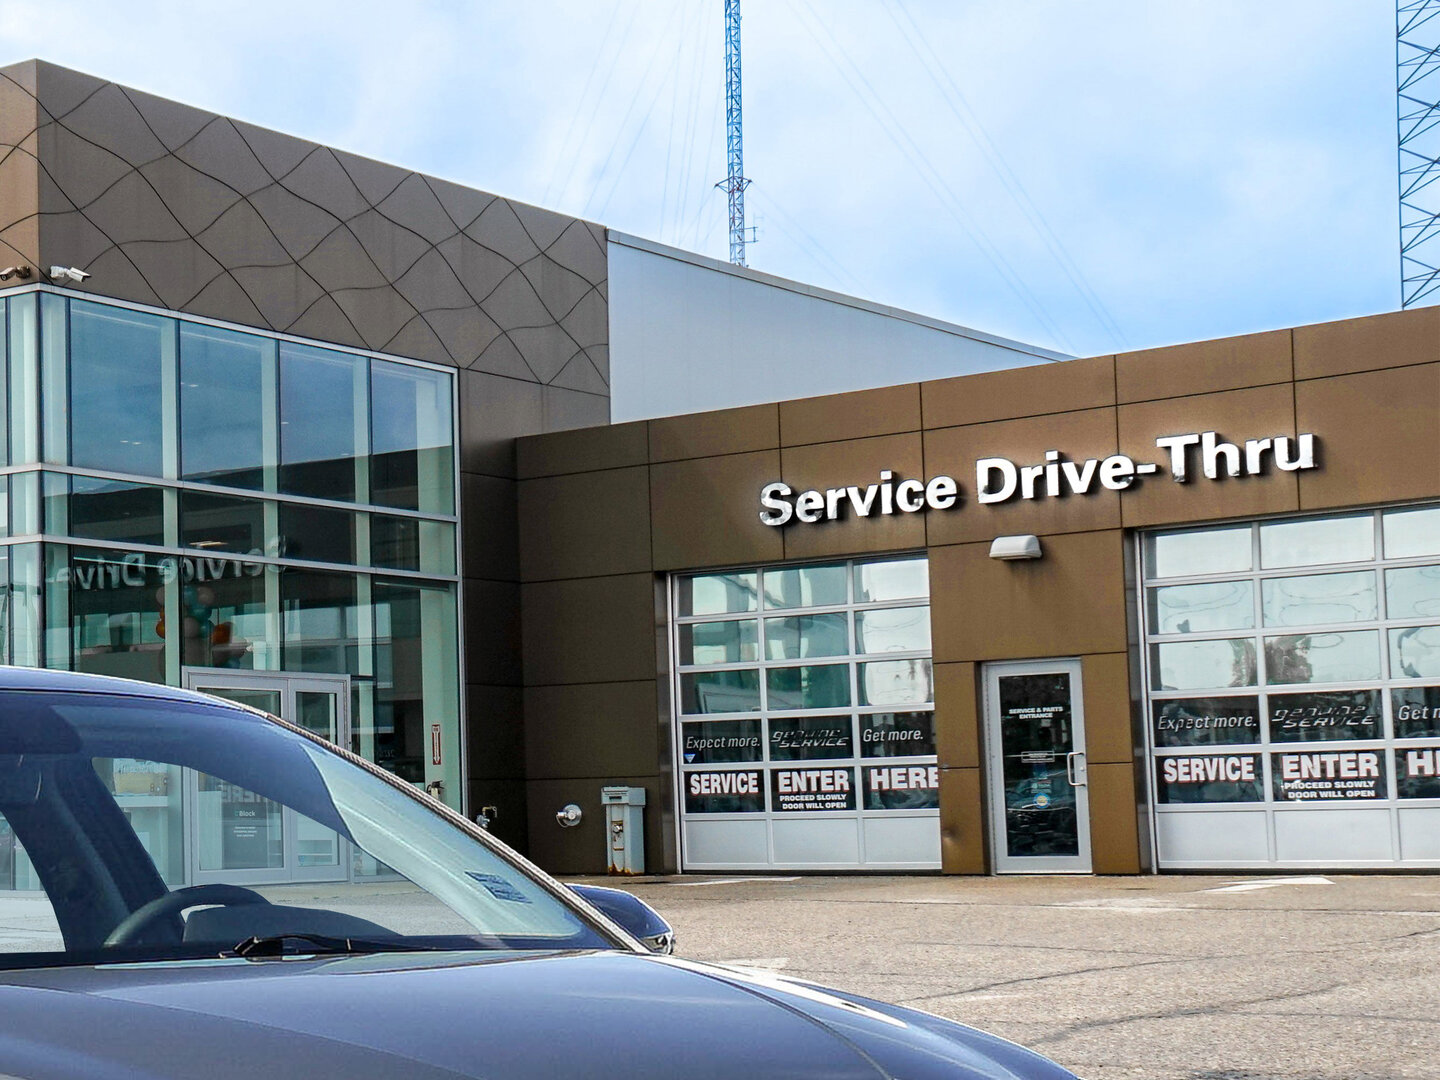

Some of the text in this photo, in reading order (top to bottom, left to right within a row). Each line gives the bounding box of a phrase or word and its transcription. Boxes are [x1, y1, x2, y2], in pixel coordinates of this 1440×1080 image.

[759, 430, 1318, 526] Service Drive-Thru
[1399, 705, 1429, 721] Get
[1158, 715, 1257, 733] Expect more.
[1282, 715, 1378, 729] SERVICE
[862, 728, 924, 742] Get more.
[686, 736, 760, 751] Expect more.
[779, 737, 850, 748] SERVICE
[1163, 756, 1255, 782] SERVICE
[1282, 752, 1380, 779] ENTER
[690, 766, 939, 795] SERVICE ENTER HERE
[1284, 780, 1376, 790] PROCEED SLOWLY
[779, 793, 847, 802] PROCEED SLOWLY
[1288, 789, 1376, 799] DOOR WILL OPEN
[825, 801, 847, 809] OPEN
